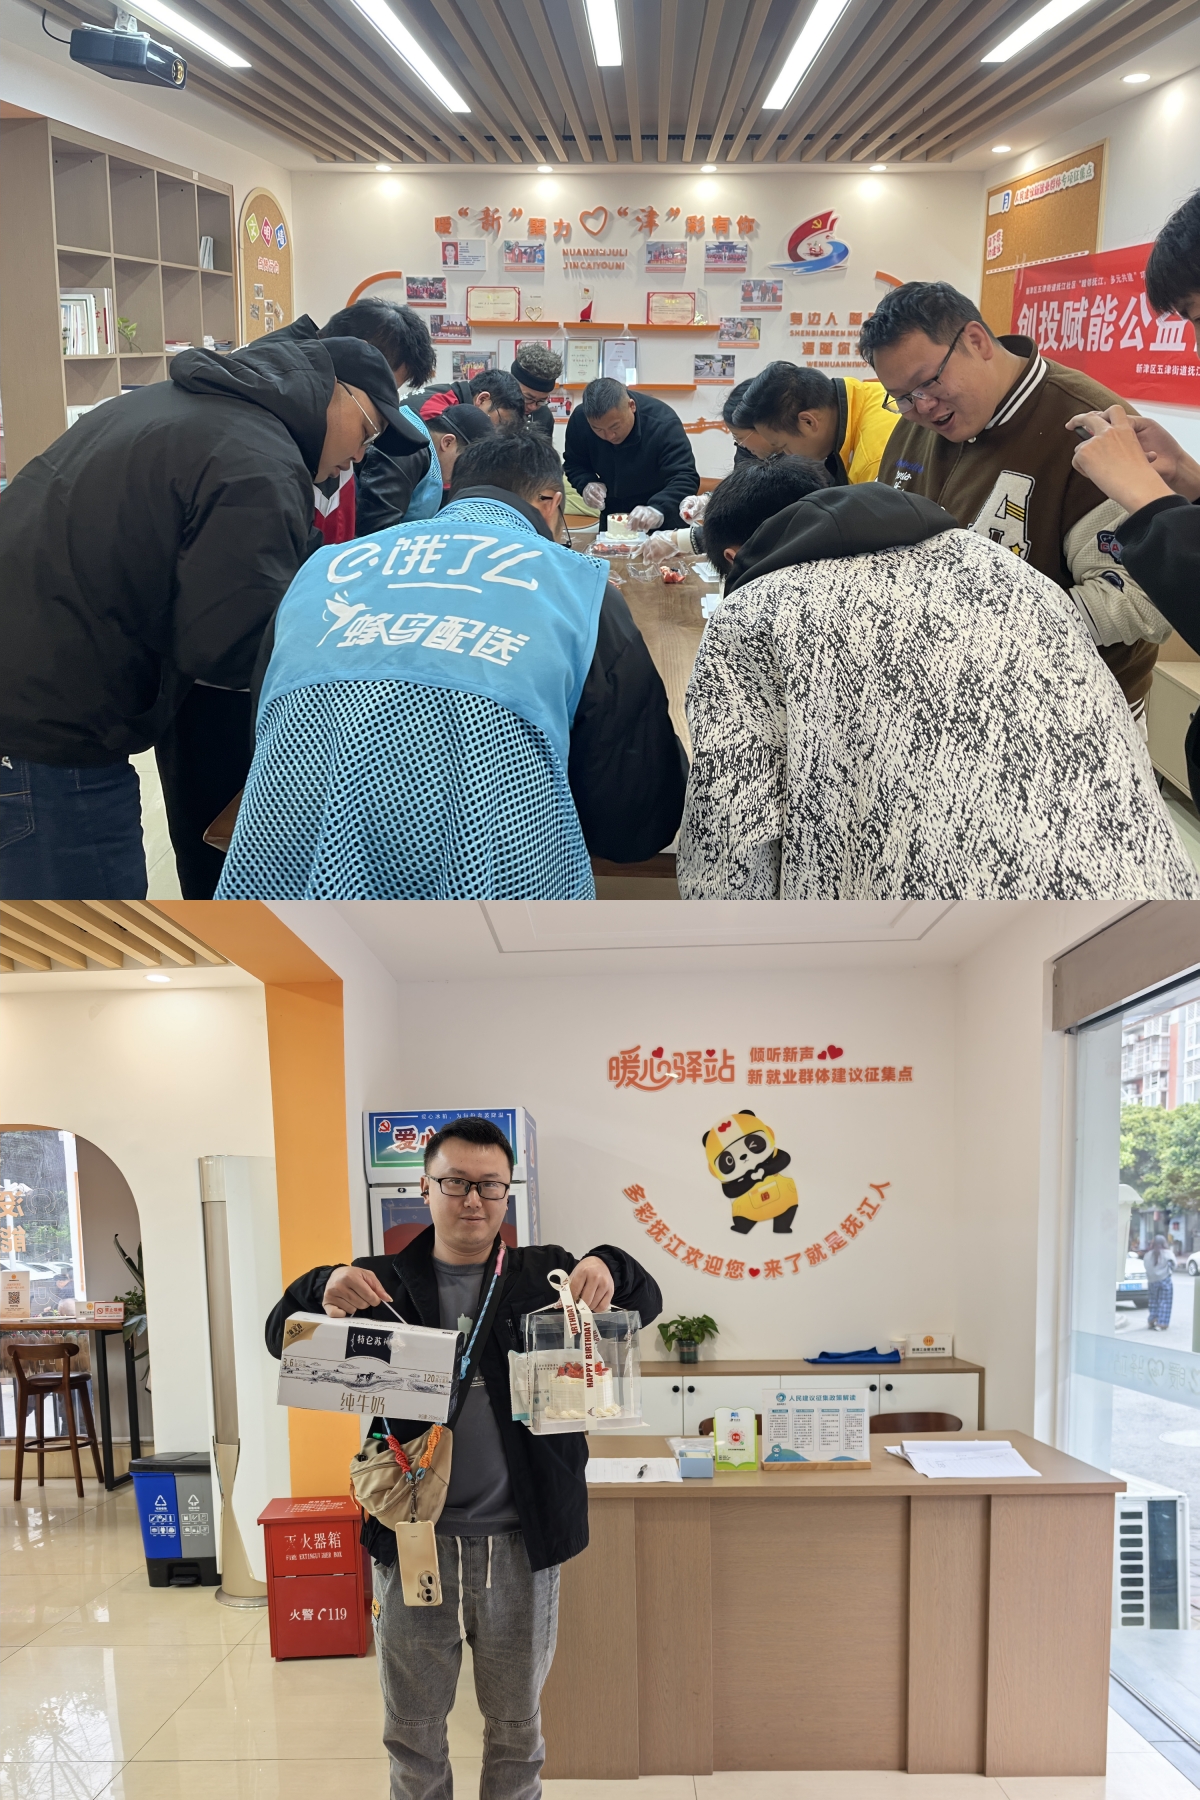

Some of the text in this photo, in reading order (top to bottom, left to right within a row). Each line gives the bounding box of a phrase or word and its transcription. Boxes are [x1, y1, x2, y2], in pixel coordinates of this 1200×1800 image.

[1017, 293, 1199, 352] 创投赋能公益
[382, 534, 542, 591] 饿了么
[336, 612, 531, 667] 蜂鸟配送
[608, 1044, 735, 1092] 暖心驿站
[749, 1046, 815, 1064] 倾听新声
[747, 1066, 914, 1086] 新就业群体建议征集点
[623, 1183, 746, 1280] 多彩抚江欢迎您
[763, 1181, 891, 1280] 来了就是抚江人
[357, 1334, 382, 1346] 特仑苏
[583, 1321, 594, 1388] HAPPY BIRTHDAY
[423, 1373, 435, 1383] 120
[340, 1392, 386, 1415] 纯牛奶
[788, 1393, 857, 1402] 人民建议征集政策解读
[289, 1607, 348, 1622] 火警 119
